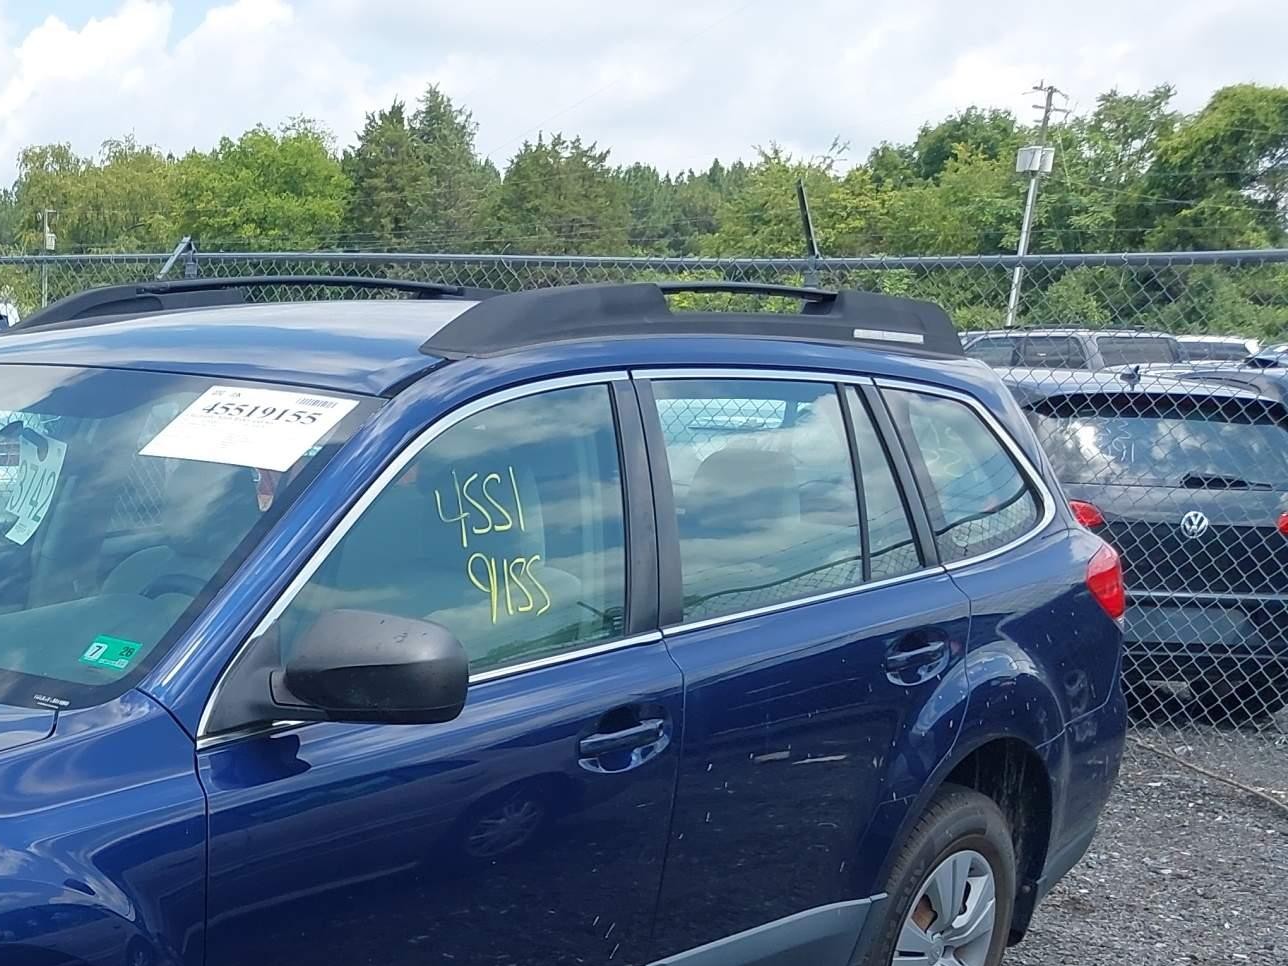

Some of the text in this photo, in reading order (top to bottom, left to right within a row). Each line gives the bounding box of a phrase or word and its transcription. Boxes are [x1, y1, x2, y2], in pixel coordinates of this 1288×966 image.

[202, 401, 323, 425] 45519155
[434, 465, 526, 548] 4551
[467, 552, 552, 625] 9155
[89, 645, 103, 657] 7
